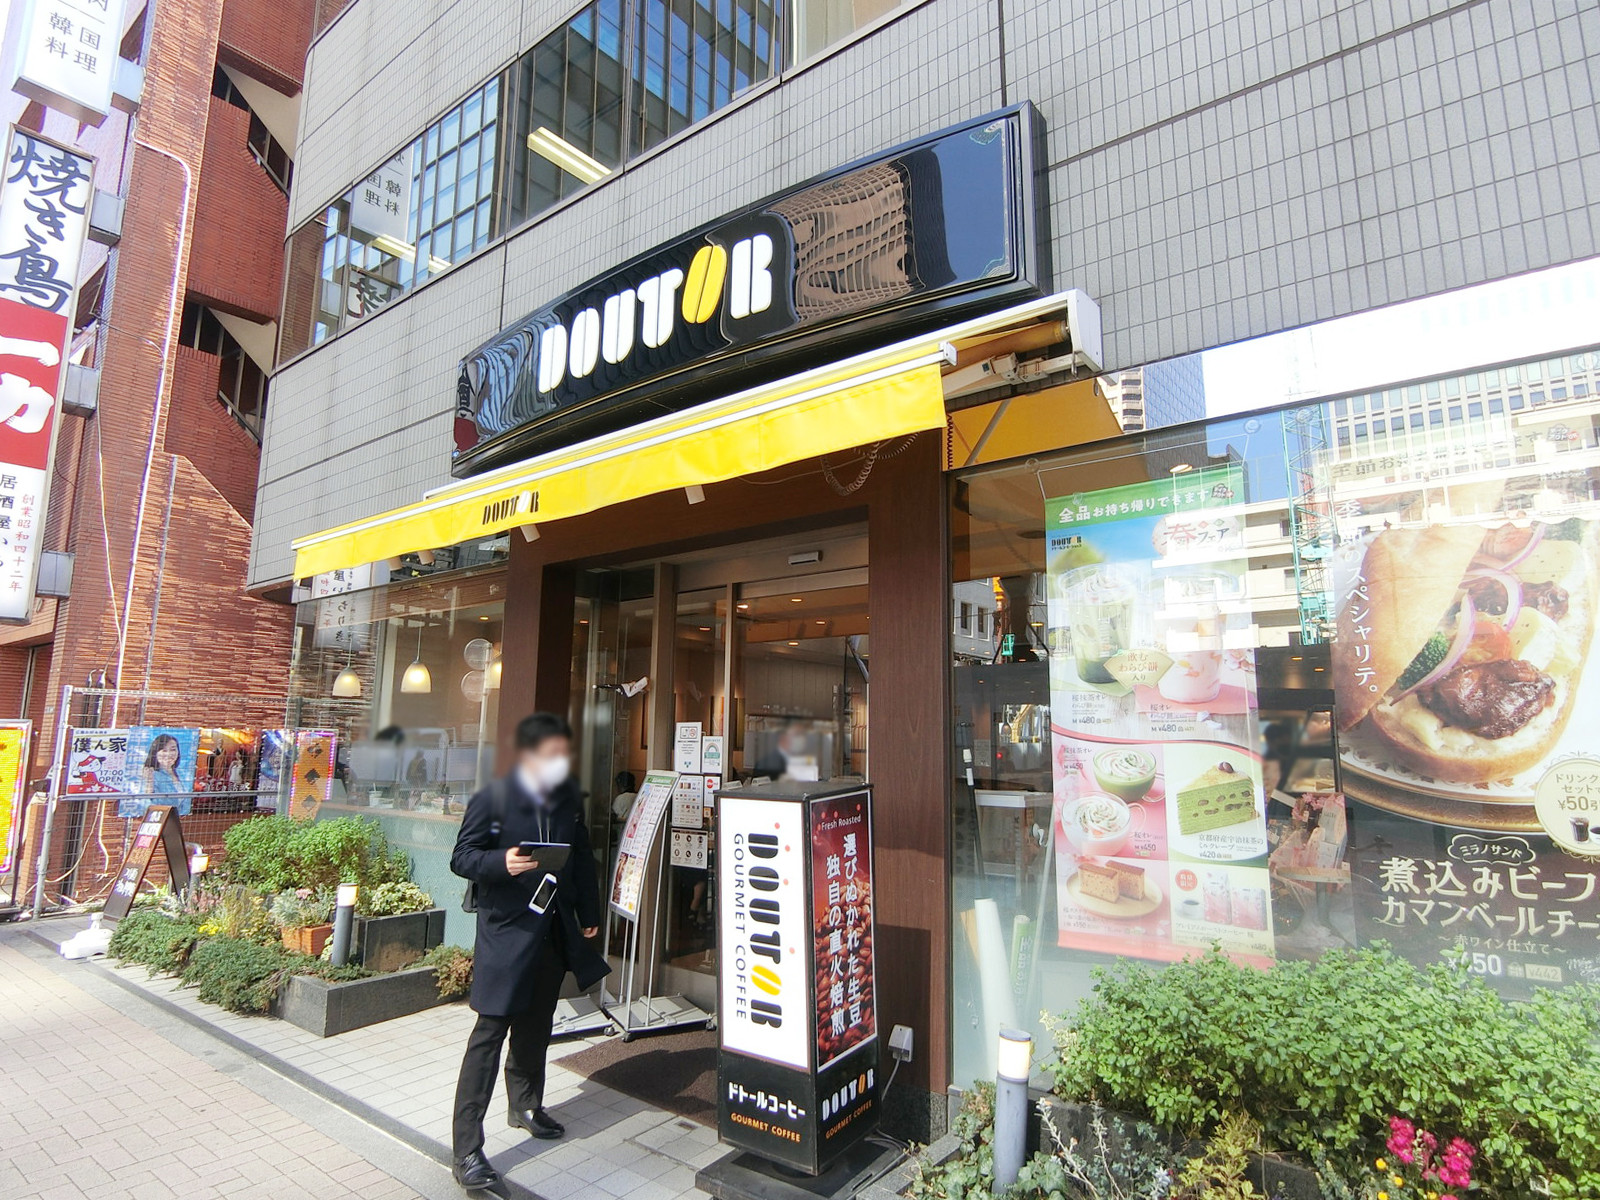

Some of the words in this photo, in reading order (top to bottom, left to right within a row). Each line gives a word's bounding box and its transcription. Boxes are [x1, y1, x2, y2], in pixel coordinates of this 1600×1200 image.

[0, 136, 90, 314] 焼き鳥
[538, 234, 773, 393] DOUTOR
[482, 490, 539, 524] DOUTOR
[1058, 490, 1209, 524] 全品お持ち帰りできます
[8, 493, 35, 592] 創業昭和四十二年
[74, 737, 127, 753] 僕ん家
[821, 818, 838, 830] Fresh
[838, 814, 862, 829] Roasted
[1459, 843, 1523, 859] ミラノサンド
[733, 833, 746, 933] GOURMET
[1379, 856, 1597, 903] 煮込みビーフ
[748, 833, 782, 1029] DOUTOR
[843, 832, 863, 1029] 選びぬかれた生豆
[1381, 895, 1600, 941] カマンベールチー
[826, 854, 845, 1039] 独自の直火焙煎
[735, 945, 747, 1019] COFFEE
[728, 1081, 806, 1119] ドトールコーヒー
[822, 1069, 875, 1121] DOUTOR
[730, 1112, 769, 1132] GOURMET
[771, 1125, 801, 1143] COFFEE
[825, 1113, 853, 1139] GOURMET
[852, 1099, 873, 1118] COFFEE
